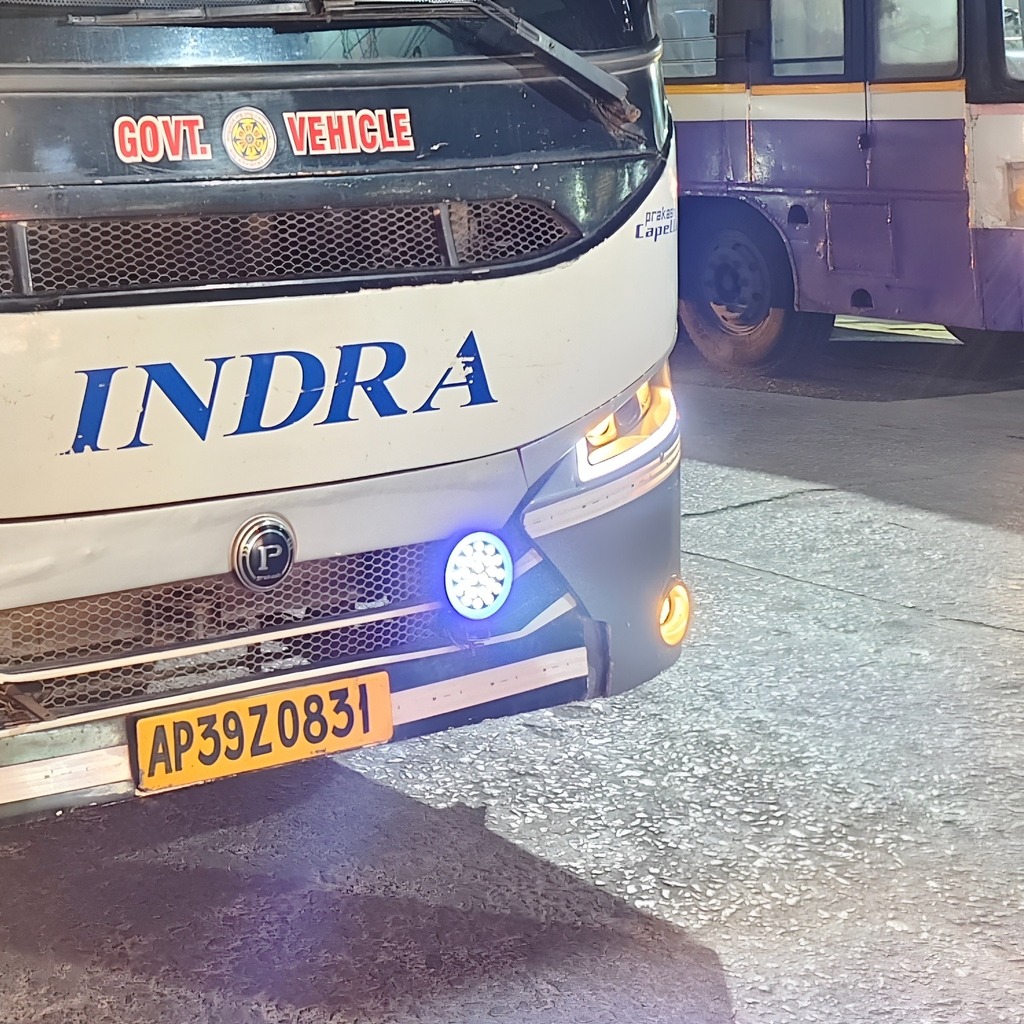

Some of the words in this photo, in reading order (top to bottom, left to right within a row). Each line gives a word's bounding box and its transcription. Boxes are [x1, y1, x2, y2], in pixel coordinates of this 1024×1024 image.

[114, 114, 213, 163] GOVT.
[283, 108, 415, 157] VEHICLE
[56, 330, 498, 456] INDRA
[147, 682, 370, 777] AP39Z0831
